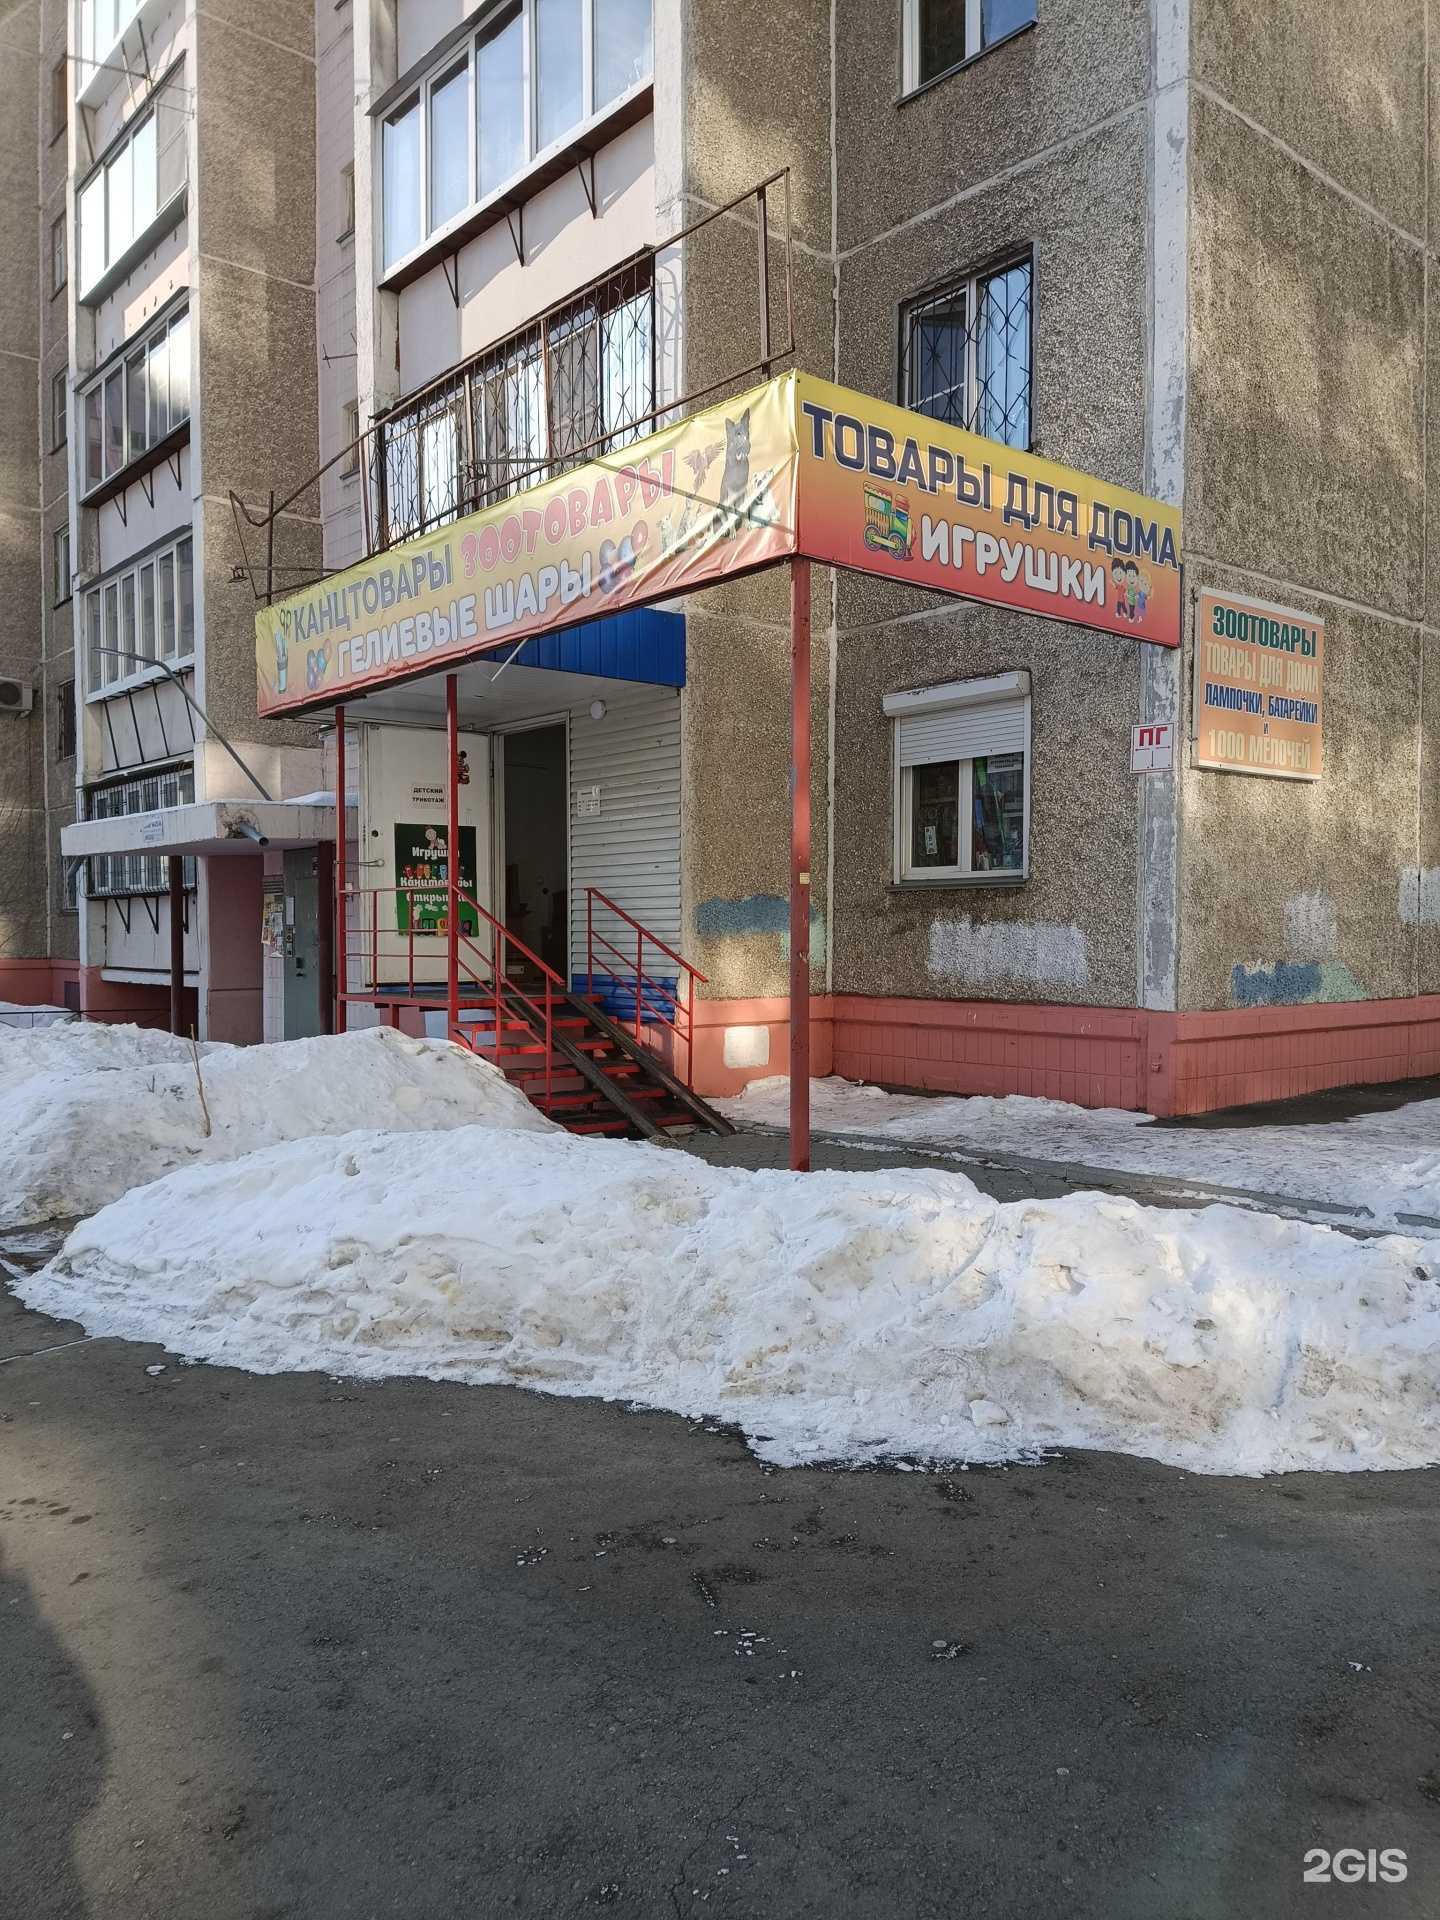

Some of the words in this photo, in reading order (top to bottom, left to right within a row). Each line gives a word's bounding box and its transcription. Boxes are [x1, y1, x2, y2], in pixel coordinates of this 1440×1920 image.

[801, 400, 992, 512] ТОВАРЫ
[1002, 470, 1079, 538] ДЛЯ
[1088, 502, 1181, 570] ДОМА
[293, 544, 453, 642] КАНЦТОВАРЫ
[461, 449, 676, 578] ЗООТОВАРЫ
[921, 514, 1106, 606] ИГРУШКИ
[337, 594, 478, 678] ГЕЛИЕВЫЕ
[484, 551, 592, 630] ШАРЫ
[1212, 605, 1318, 658] ЗООТОВАРЫ
[1206, 642, 1257, 681] ТОВАРЫ
[1259, 654, 1283, 688] ДЛЯ
[1286, 660, 1320, 694] ДОМА
[1205, 682, 1265, 718] ЛАМПОЧКИ,
[1268, 695, 1318, 724] БАТАРЕЙКИ
[1139, 726, 1168, 746] ПГ
[1209, 728, 1245, 760] 1000
[1248, 735, 1312, 768] МЕЛОЧЕЙ
[411, 846, 460, 860] Игруш
